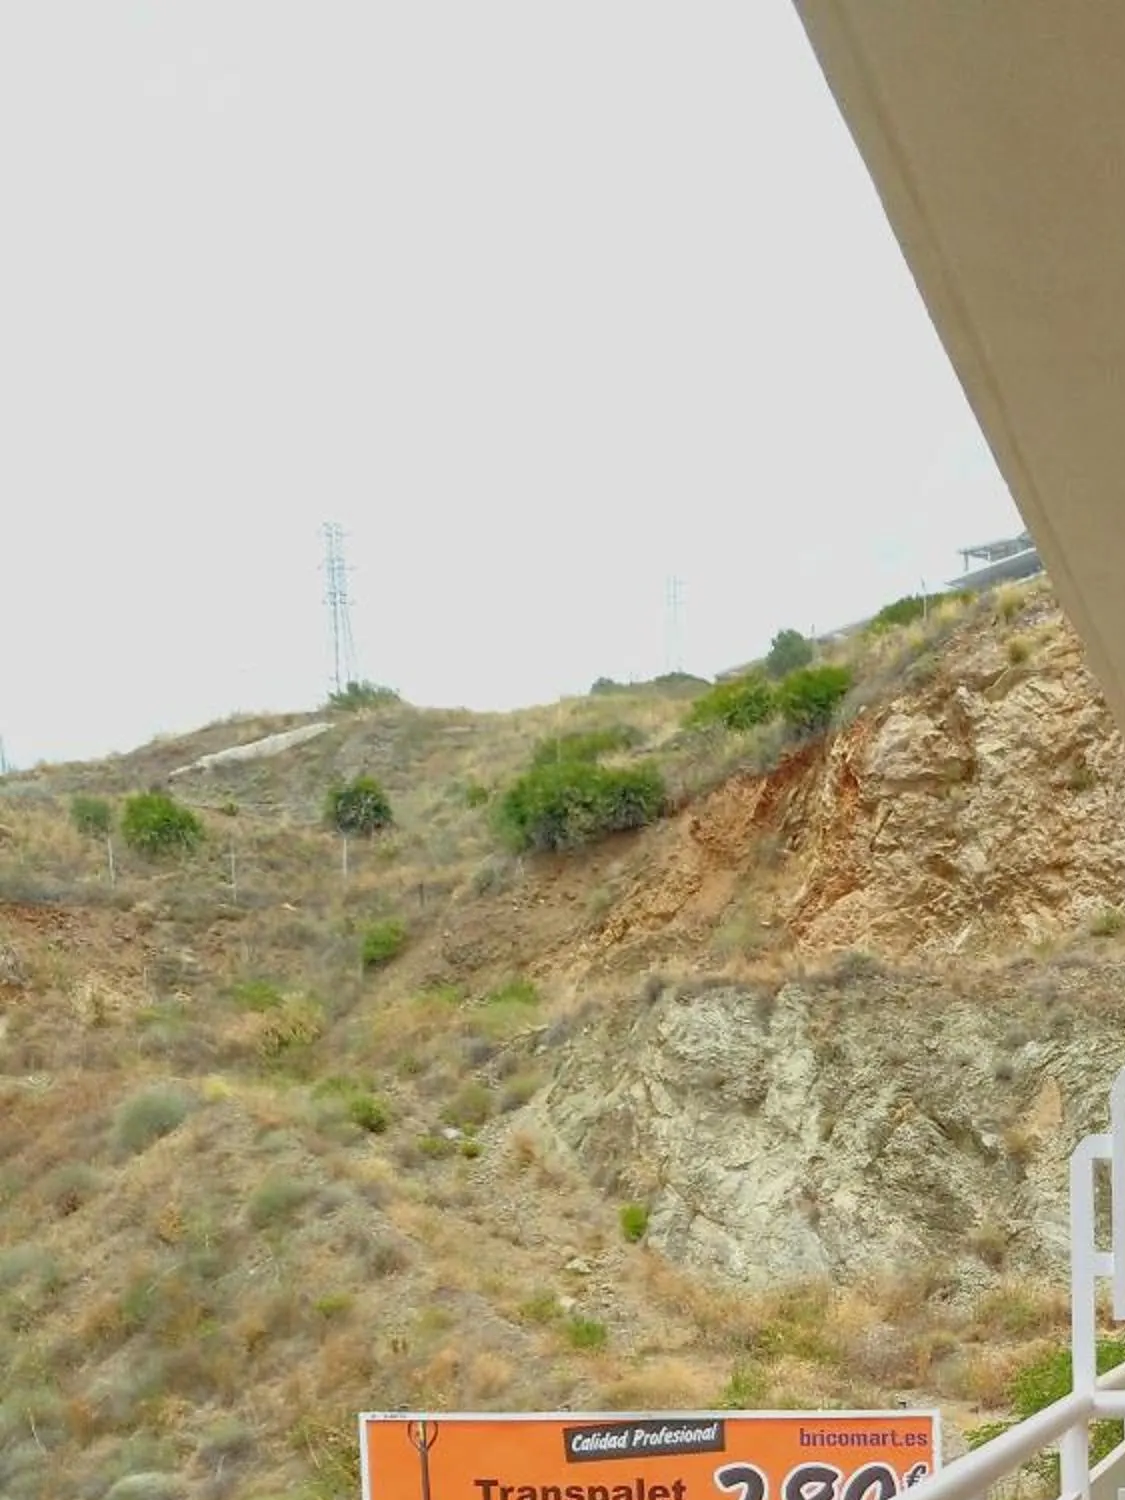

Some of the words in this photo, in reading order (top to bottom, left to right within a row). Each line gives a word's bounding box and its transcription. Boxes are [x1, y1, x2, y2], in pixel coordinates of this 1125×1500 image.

[571, 1430, 628, 1452] Calidad
[632, 1423, 718, 1447] Profesional
[799, 1427, 928, 1447] bricomart.es
